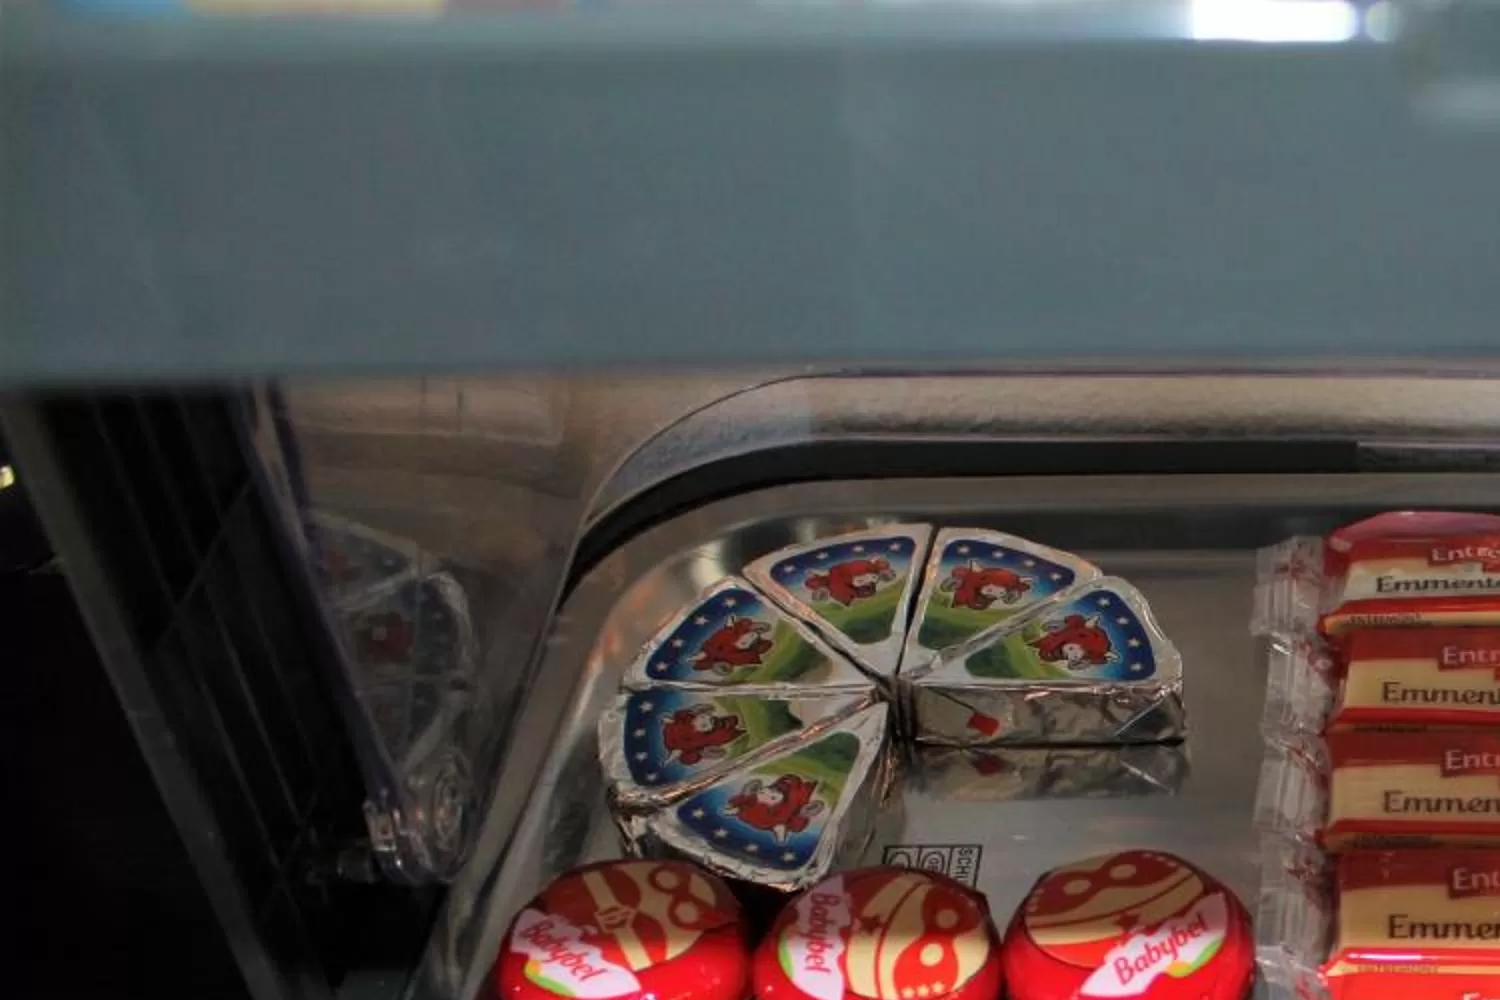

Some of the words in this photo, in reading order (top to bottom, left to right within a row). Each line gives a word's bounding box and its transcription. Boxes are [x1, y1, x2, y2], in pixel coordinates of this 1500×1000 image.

[519, 920, 608, 982] Babybel
[802, 892, 841, 974] Babybel
[1113, 911, 1209, 985] Babybel
